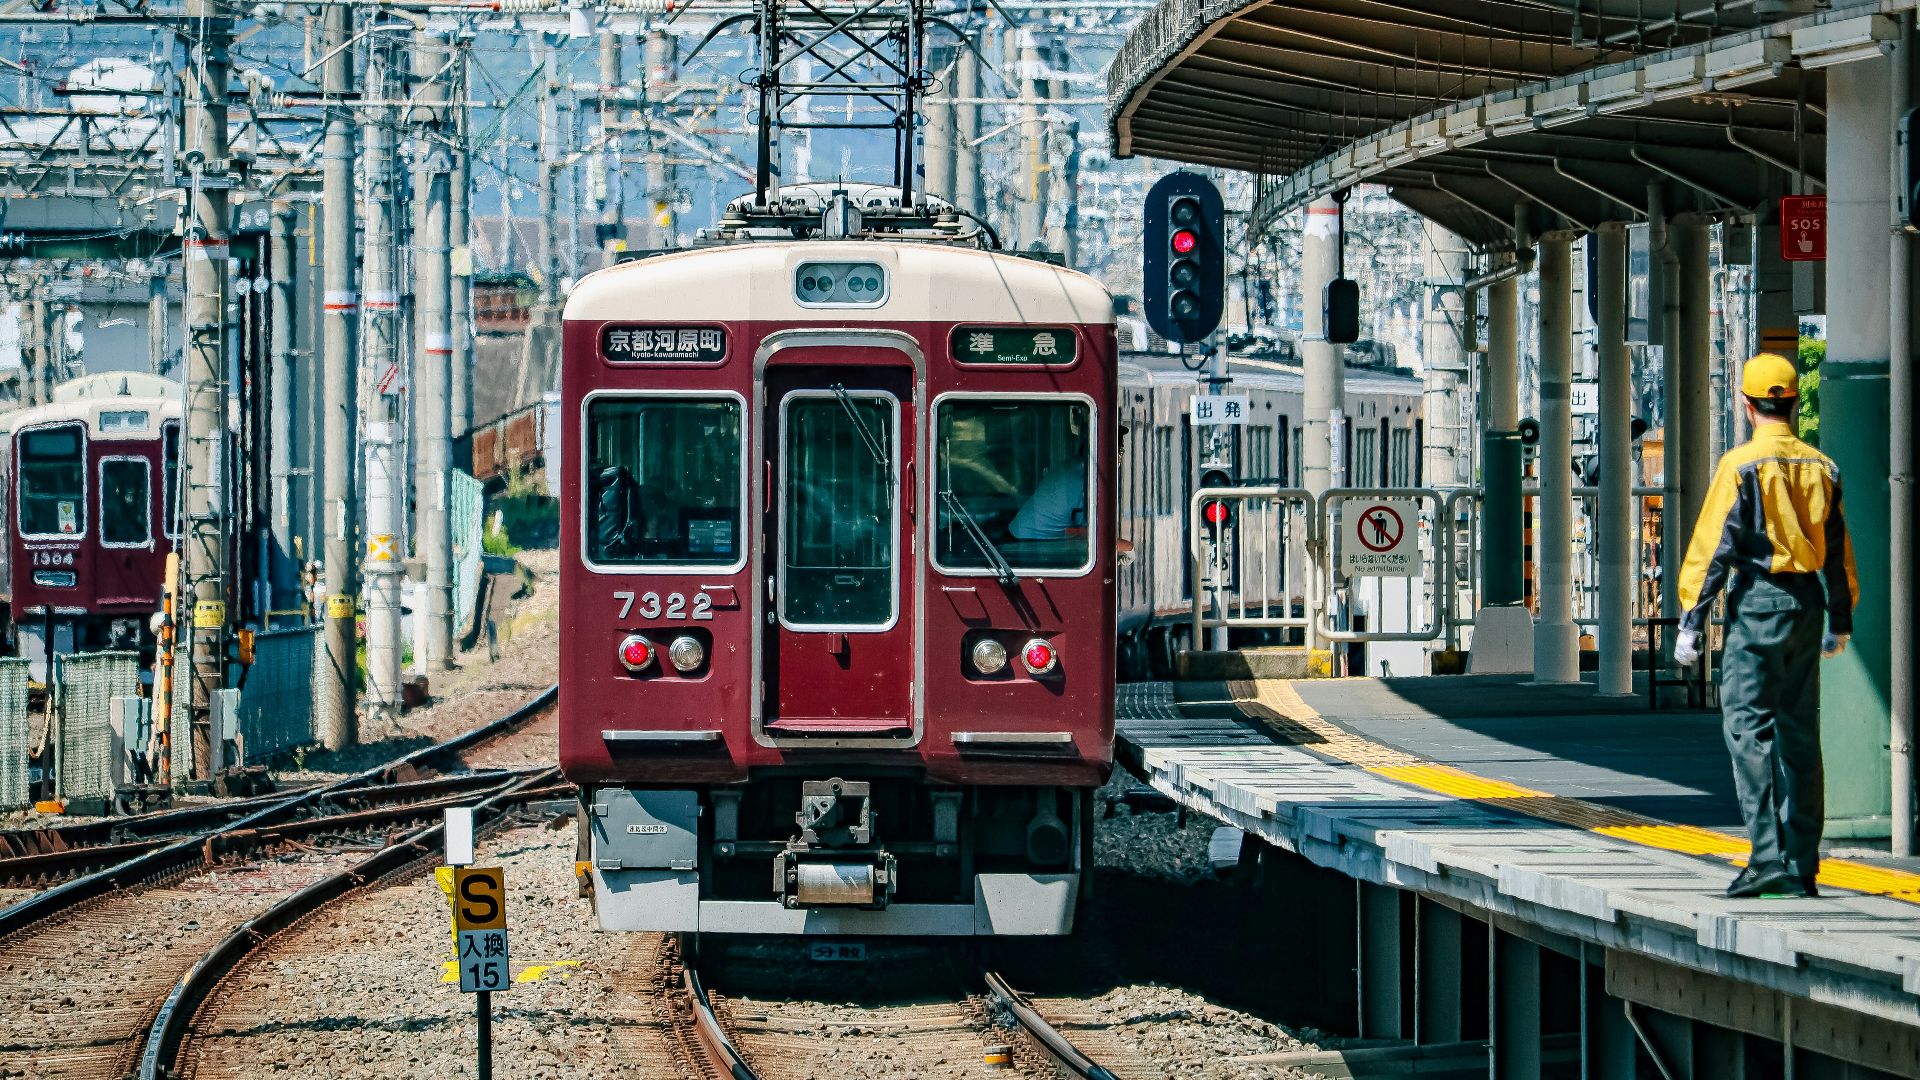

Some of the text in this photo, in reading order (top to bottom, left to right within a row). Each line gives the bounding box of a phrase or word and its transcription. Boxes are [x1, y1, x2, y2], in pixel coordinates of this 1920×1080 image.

[1791, 219, 1820, 230] SOS
[608, 329, 722, 352] 京都河原町
[969, 332, 1058, 356] 準急
[631, 351, 699, 359] Kyoto-kawaramachi
[997, 354, 1028, 362] Semi-Exp
[1197, 401, 1241, 418] 出発
[1349, 553, 1411, 564] はいらないでください
[1354, 565, 1405, 573] No admittance
[613, 591, 713, 620] 7322
[460, 873, 499, 924] S
[462, 933, 505, 959] 入換
[468, 962, 500, 989] 15
